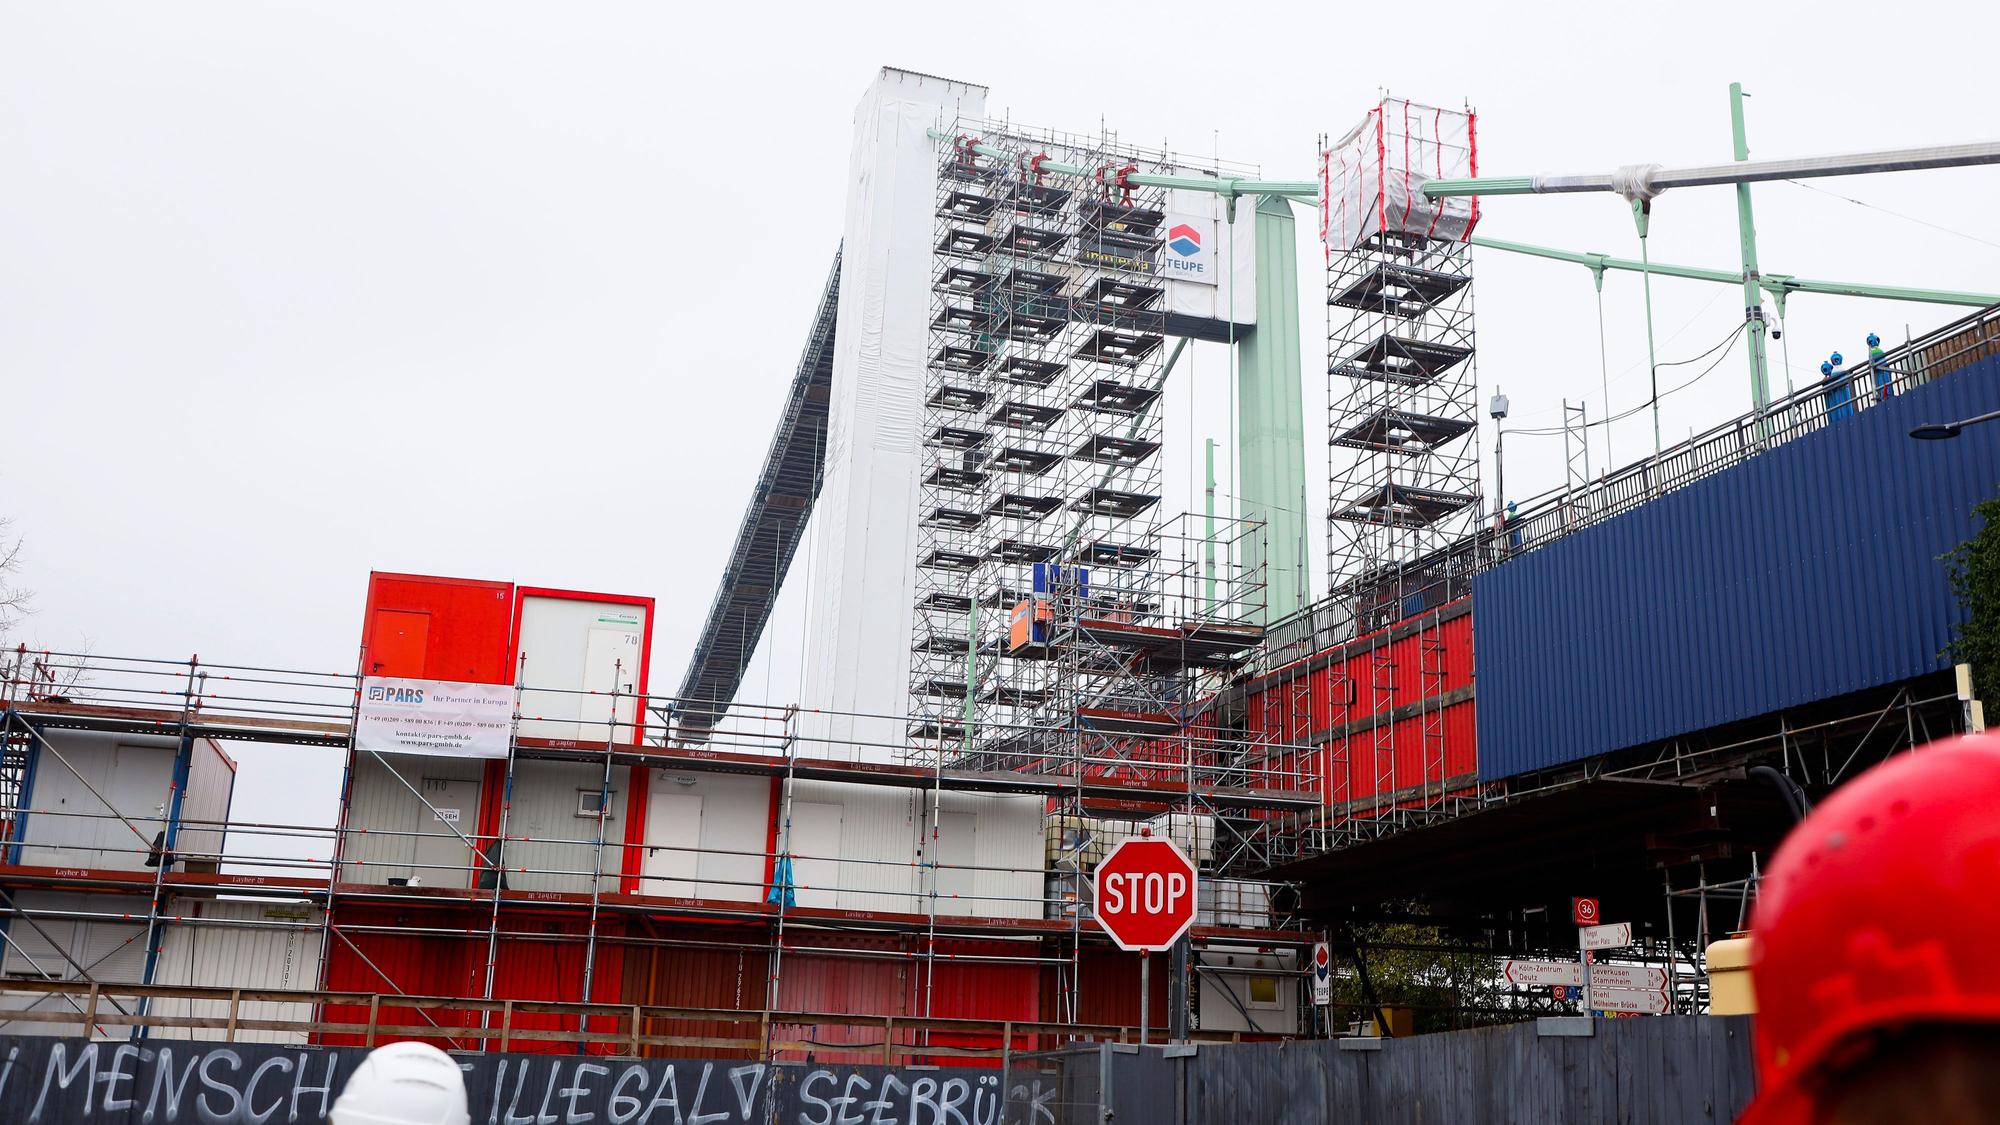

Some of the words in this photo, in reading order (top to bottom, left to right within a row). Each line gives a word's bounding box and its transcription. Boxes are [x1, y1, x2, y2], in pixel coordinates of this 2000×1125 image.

[1166, 258, 1204, 272] TEUPE
[624, 634, 638, 645] 78
[386, 687, 424, 704] PARS
[482, 698, 508, 706] Europa
[395, 730, 472, 740] kontakt@pars-gmbh.de
[400, 740, 463, 748] www.pars-gmbh.de
[427, 780, 447, 791] 110
[55, 869, 79, 877] Layher
[1105, 872, 1186, 915] STOP
[1582, 904, 1592, 914] 36
[1518, 964, 1563, 972] Köln-Zentrum
[1592, 968, 1630, 976] Leverkusen
[1593, 977, 1632, 985] Stammheim
[28, 1042, 338, 1124] MENSCH
[489, 1058, 730, 1125] ILLEGAL
